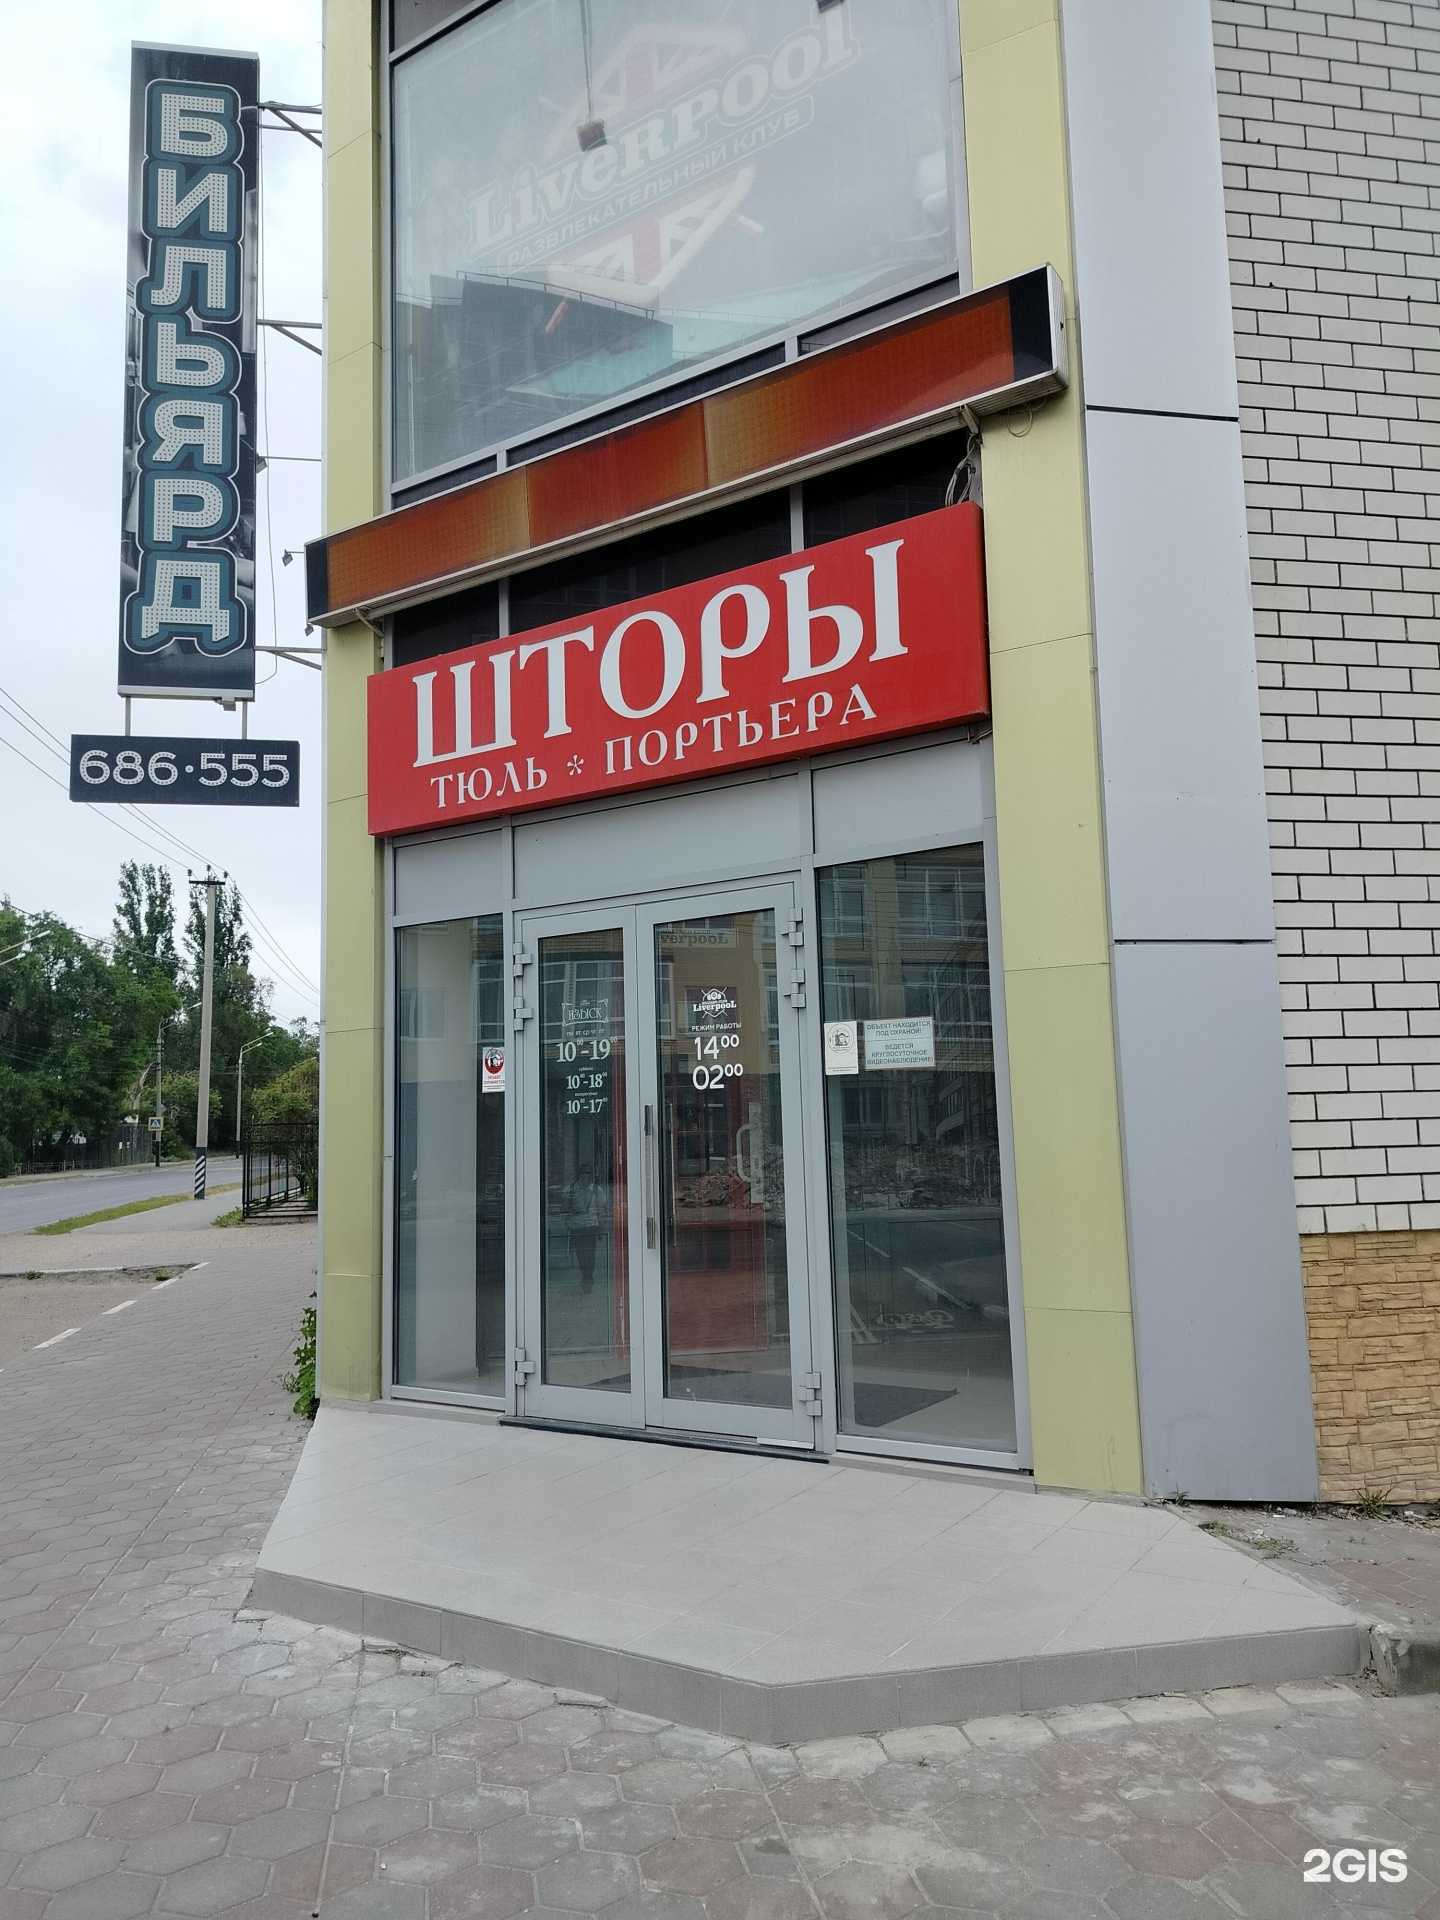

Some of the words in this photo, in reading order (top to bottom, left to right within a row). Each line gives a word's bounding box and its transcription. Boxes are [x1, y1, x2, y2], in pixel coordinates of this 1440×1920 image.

[506, 149, 728, 268] РАЗВЛЕКАТЕЛЬНЫЙ
[733, 109, 802, 158] КЛУБ
[142, 92, 230, 641] БИЛЬЯРД
[412, 539, 908, 767] ШТОРЫ
[430, 756, 548, 808] ТЮЛЬ
[605, 684, 877, 775] ПОРТЬЕРА
[716, 1021, 742, 1030] РАБОТЫ
